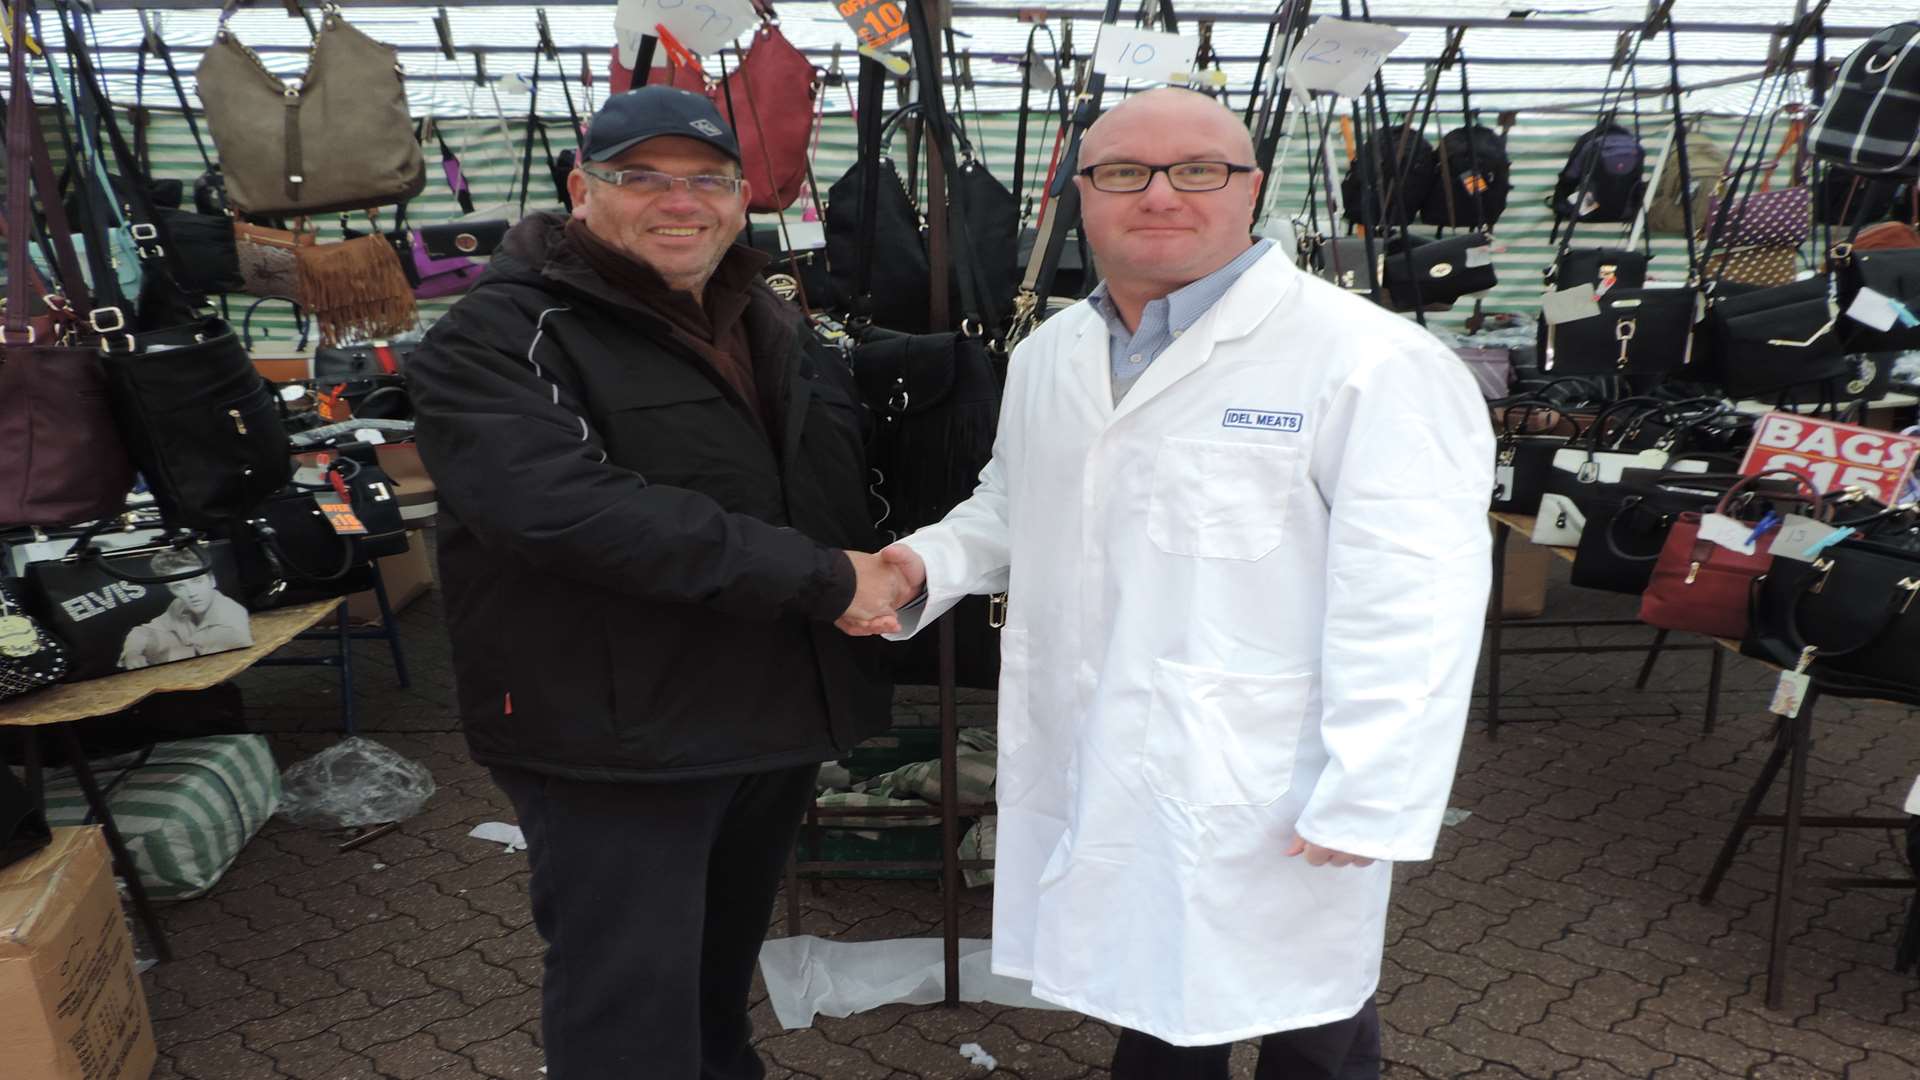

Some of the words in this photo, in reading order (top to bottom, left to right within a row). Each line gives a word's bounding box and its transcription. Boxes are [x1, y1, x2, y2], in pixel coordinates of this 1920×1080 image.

[1118, 41, 1156, 66] 10
[1227, 412, 1252, 425] IDEL
[1256, 414, 1297, 428] MEATS
[1759, 418, 1911, 469] BAGS
[61, 580, 146, 622] ELVIS
